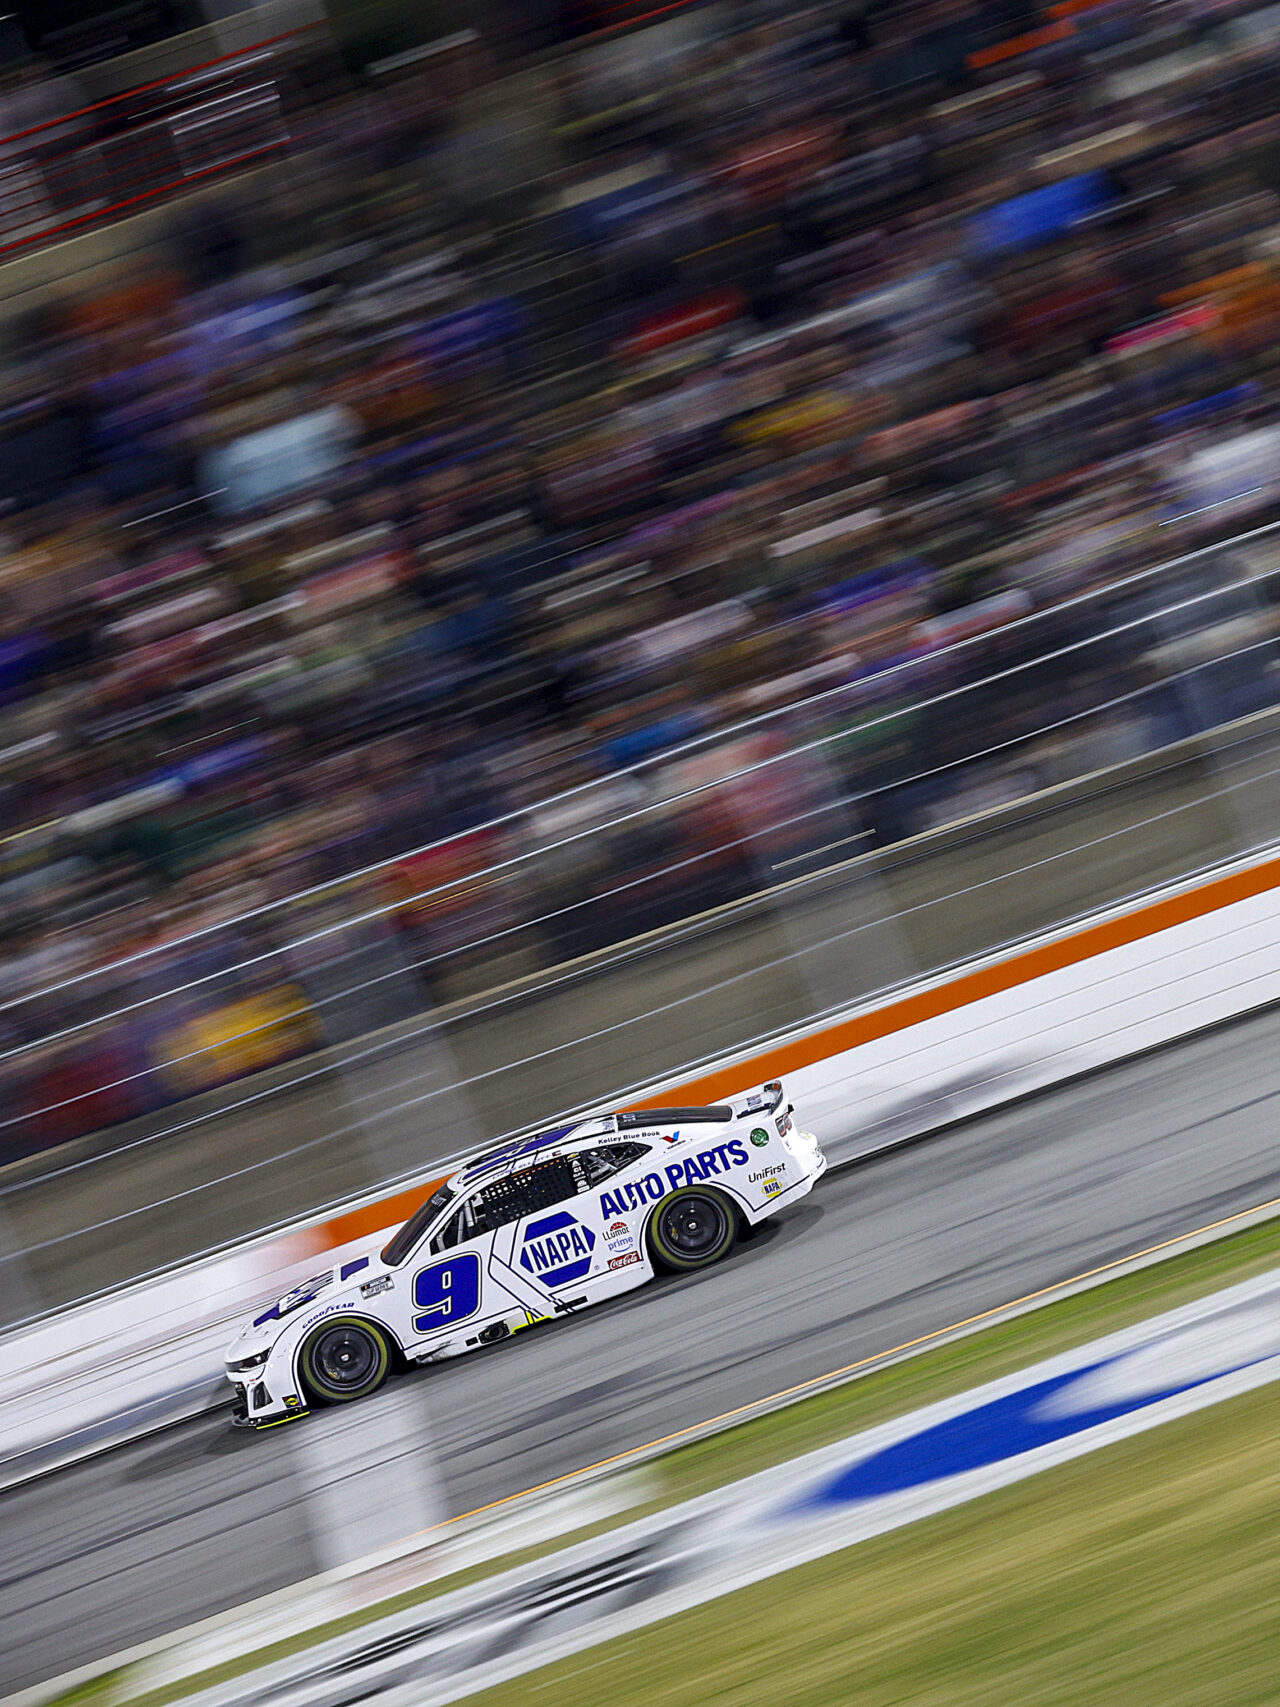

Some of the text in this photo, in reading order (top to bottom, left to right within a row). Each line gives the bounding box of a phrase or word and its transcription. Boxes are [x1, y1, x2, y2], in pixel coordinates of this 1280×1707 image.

[598, 1135, 621, 1145] Kelley
[600, 1140, 749, 1220] AUTO PARTS
[748, 1163, 786, 1183] UniFirst
[763, 1181, 781, 1195] NAPA
[530, 1228, 587, 1271] NAPA
[608, 1236, 634, 1251] prime
[412, 1252, 482, 1333] 9
[302, 1302, 355, 1329] GOODYEAR
